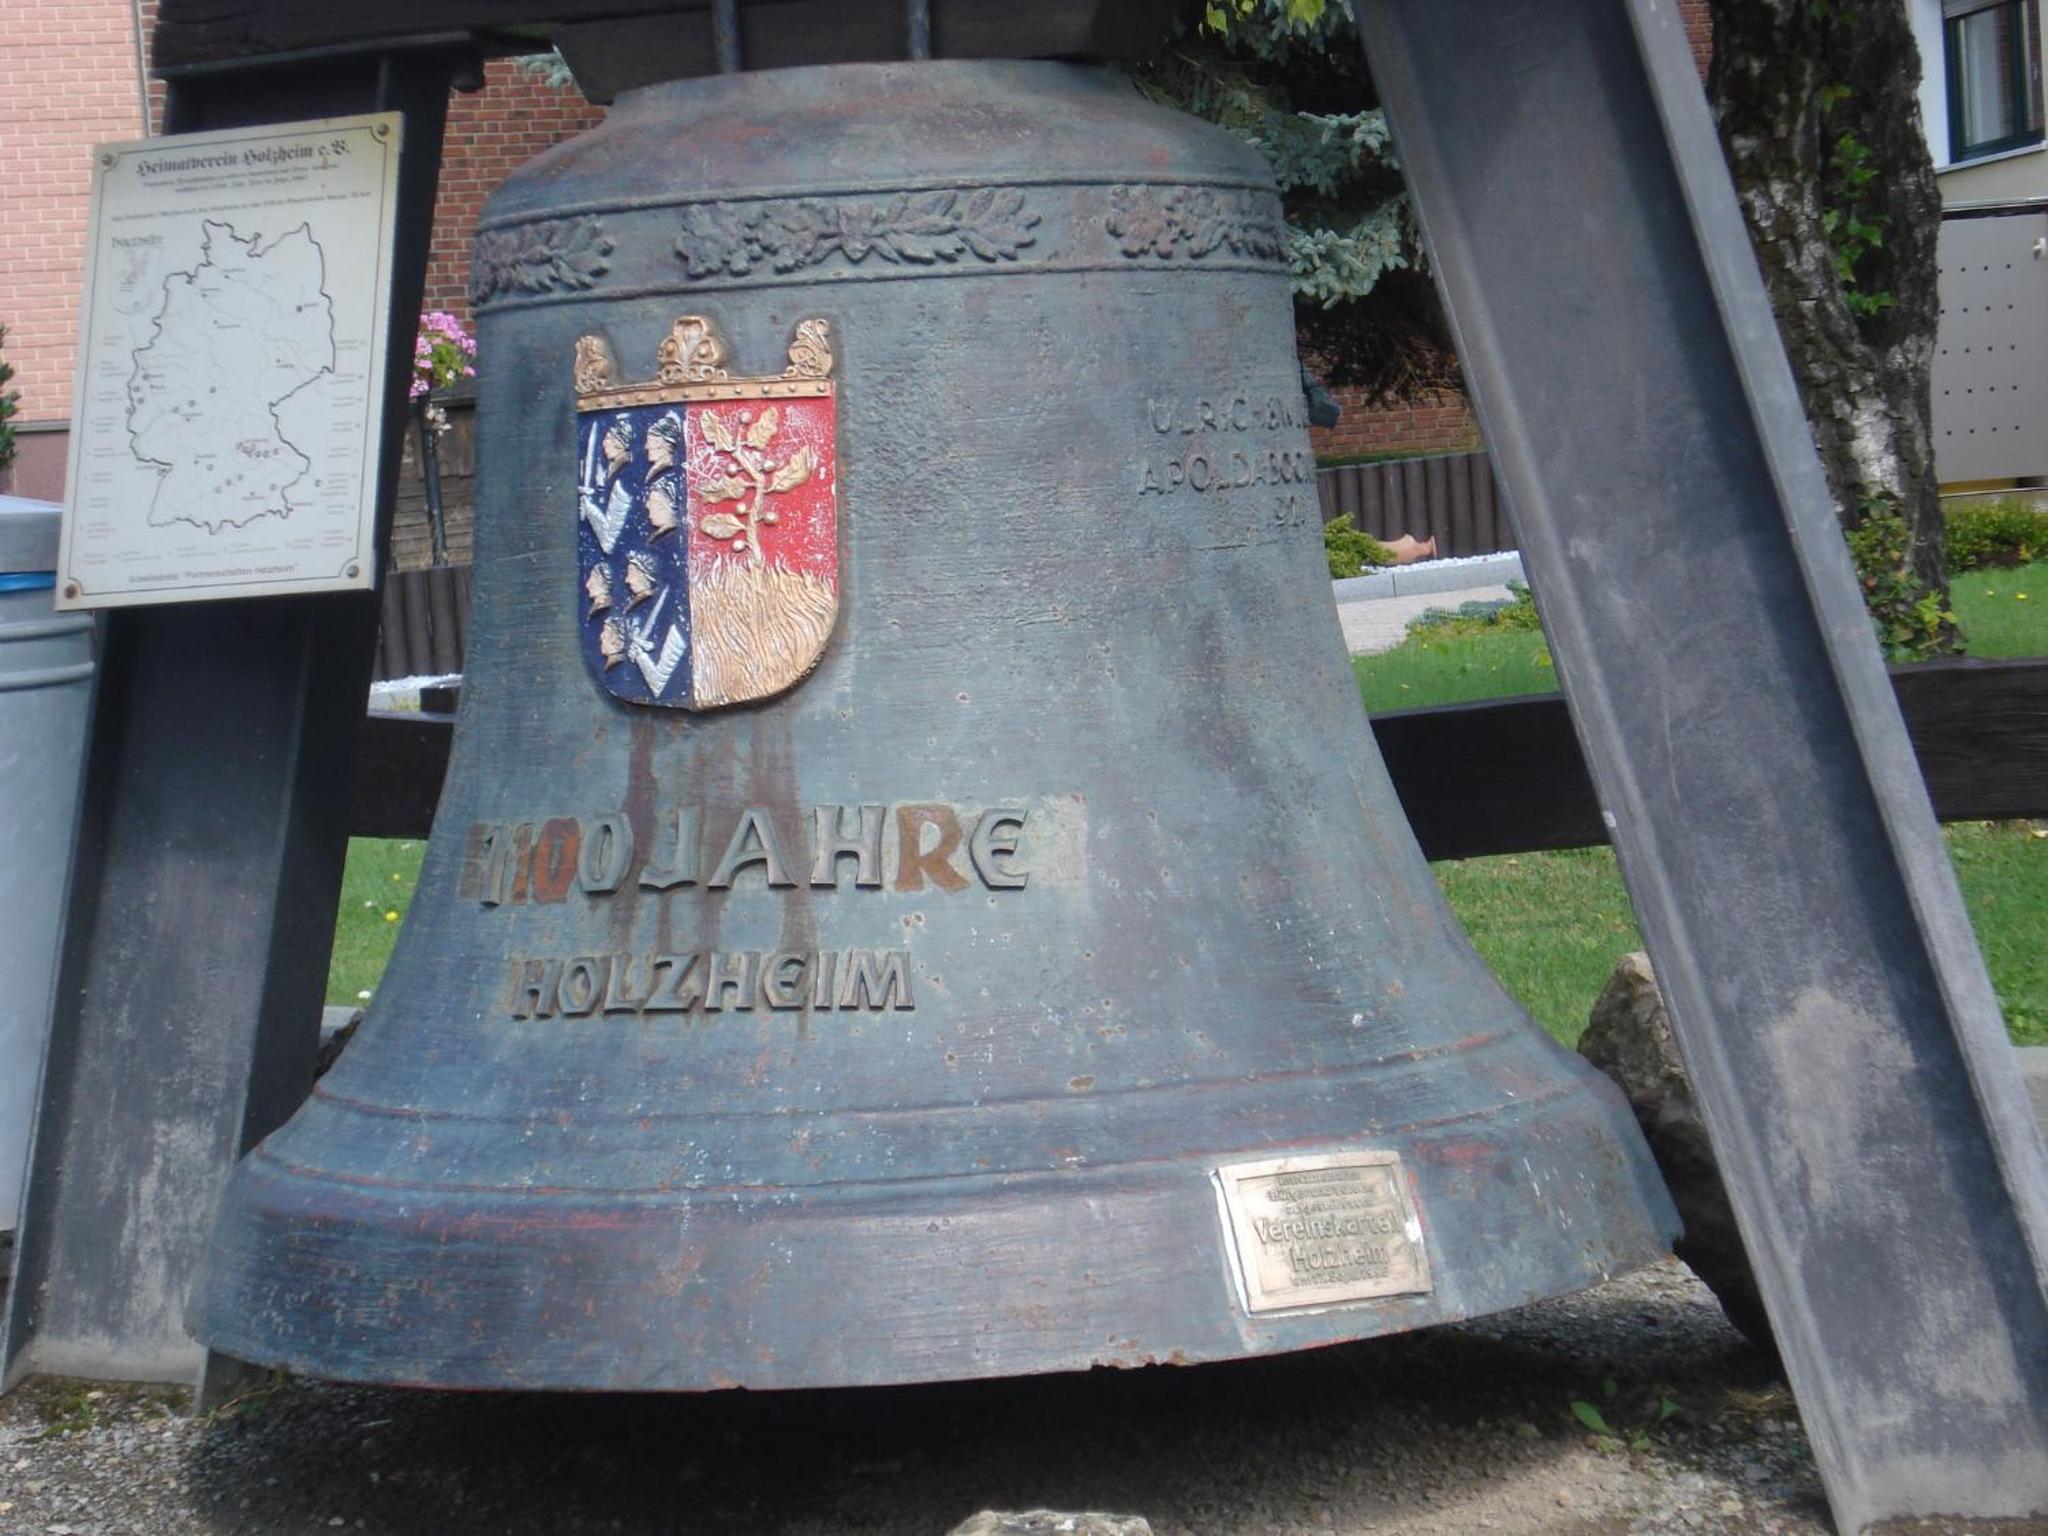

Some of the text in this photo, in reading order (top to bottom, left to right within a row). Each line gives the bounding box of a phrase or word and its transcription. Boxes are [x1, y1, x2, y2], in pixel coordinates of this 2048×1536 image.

[136, 153, 238, 177] Heimatverein
[241, 144, 313, 167] Holzheim
[638, 804, 1032, 891] JAHRE
[508, 950, 915, 1021] HOLZHEIM
[1253, 1210, 1399, 1245] Vereinskartell
[1289, 1243, 1390, 1273] Holzheim
